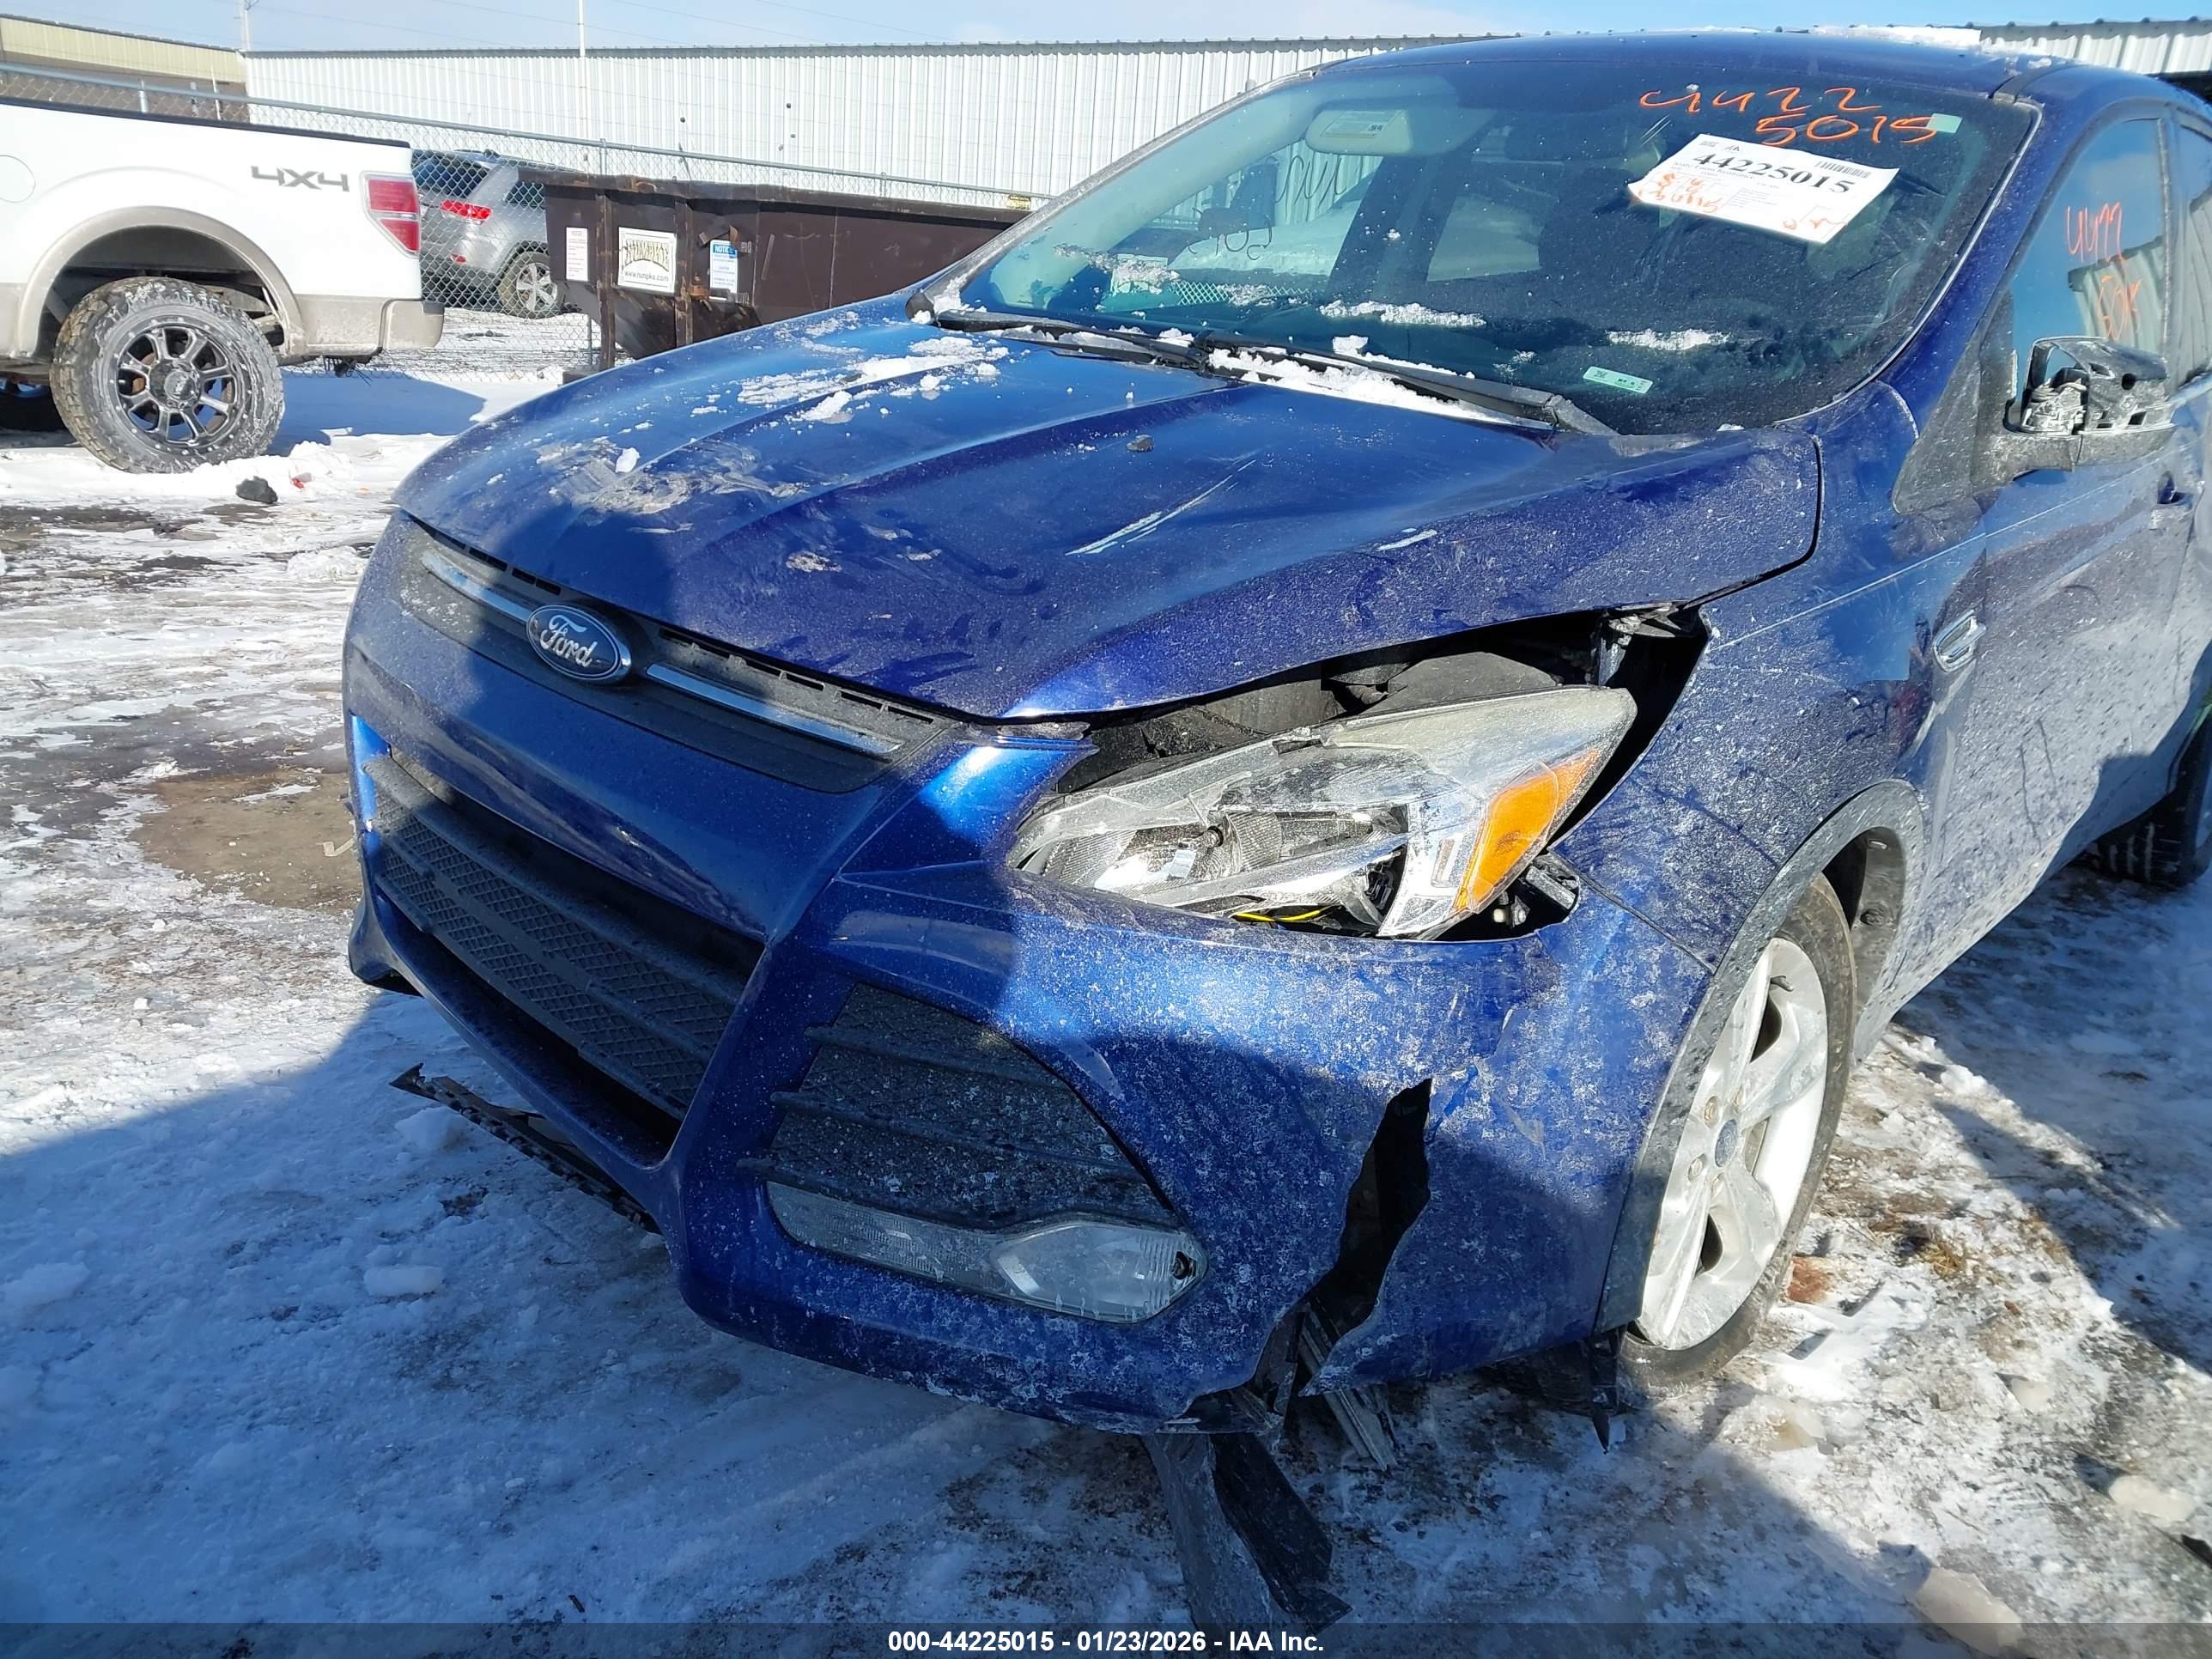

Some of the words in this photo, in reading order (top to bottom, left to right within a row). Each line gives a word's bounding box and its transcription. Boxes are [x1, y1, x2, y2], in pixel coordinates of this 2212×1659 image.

[1638, 87, 1882, 113] 4422
[1755, 113, 1938, 146] 5015
[1692, 154, 1856, 194] 44225015
[539, 614, 599, 667] Ford
